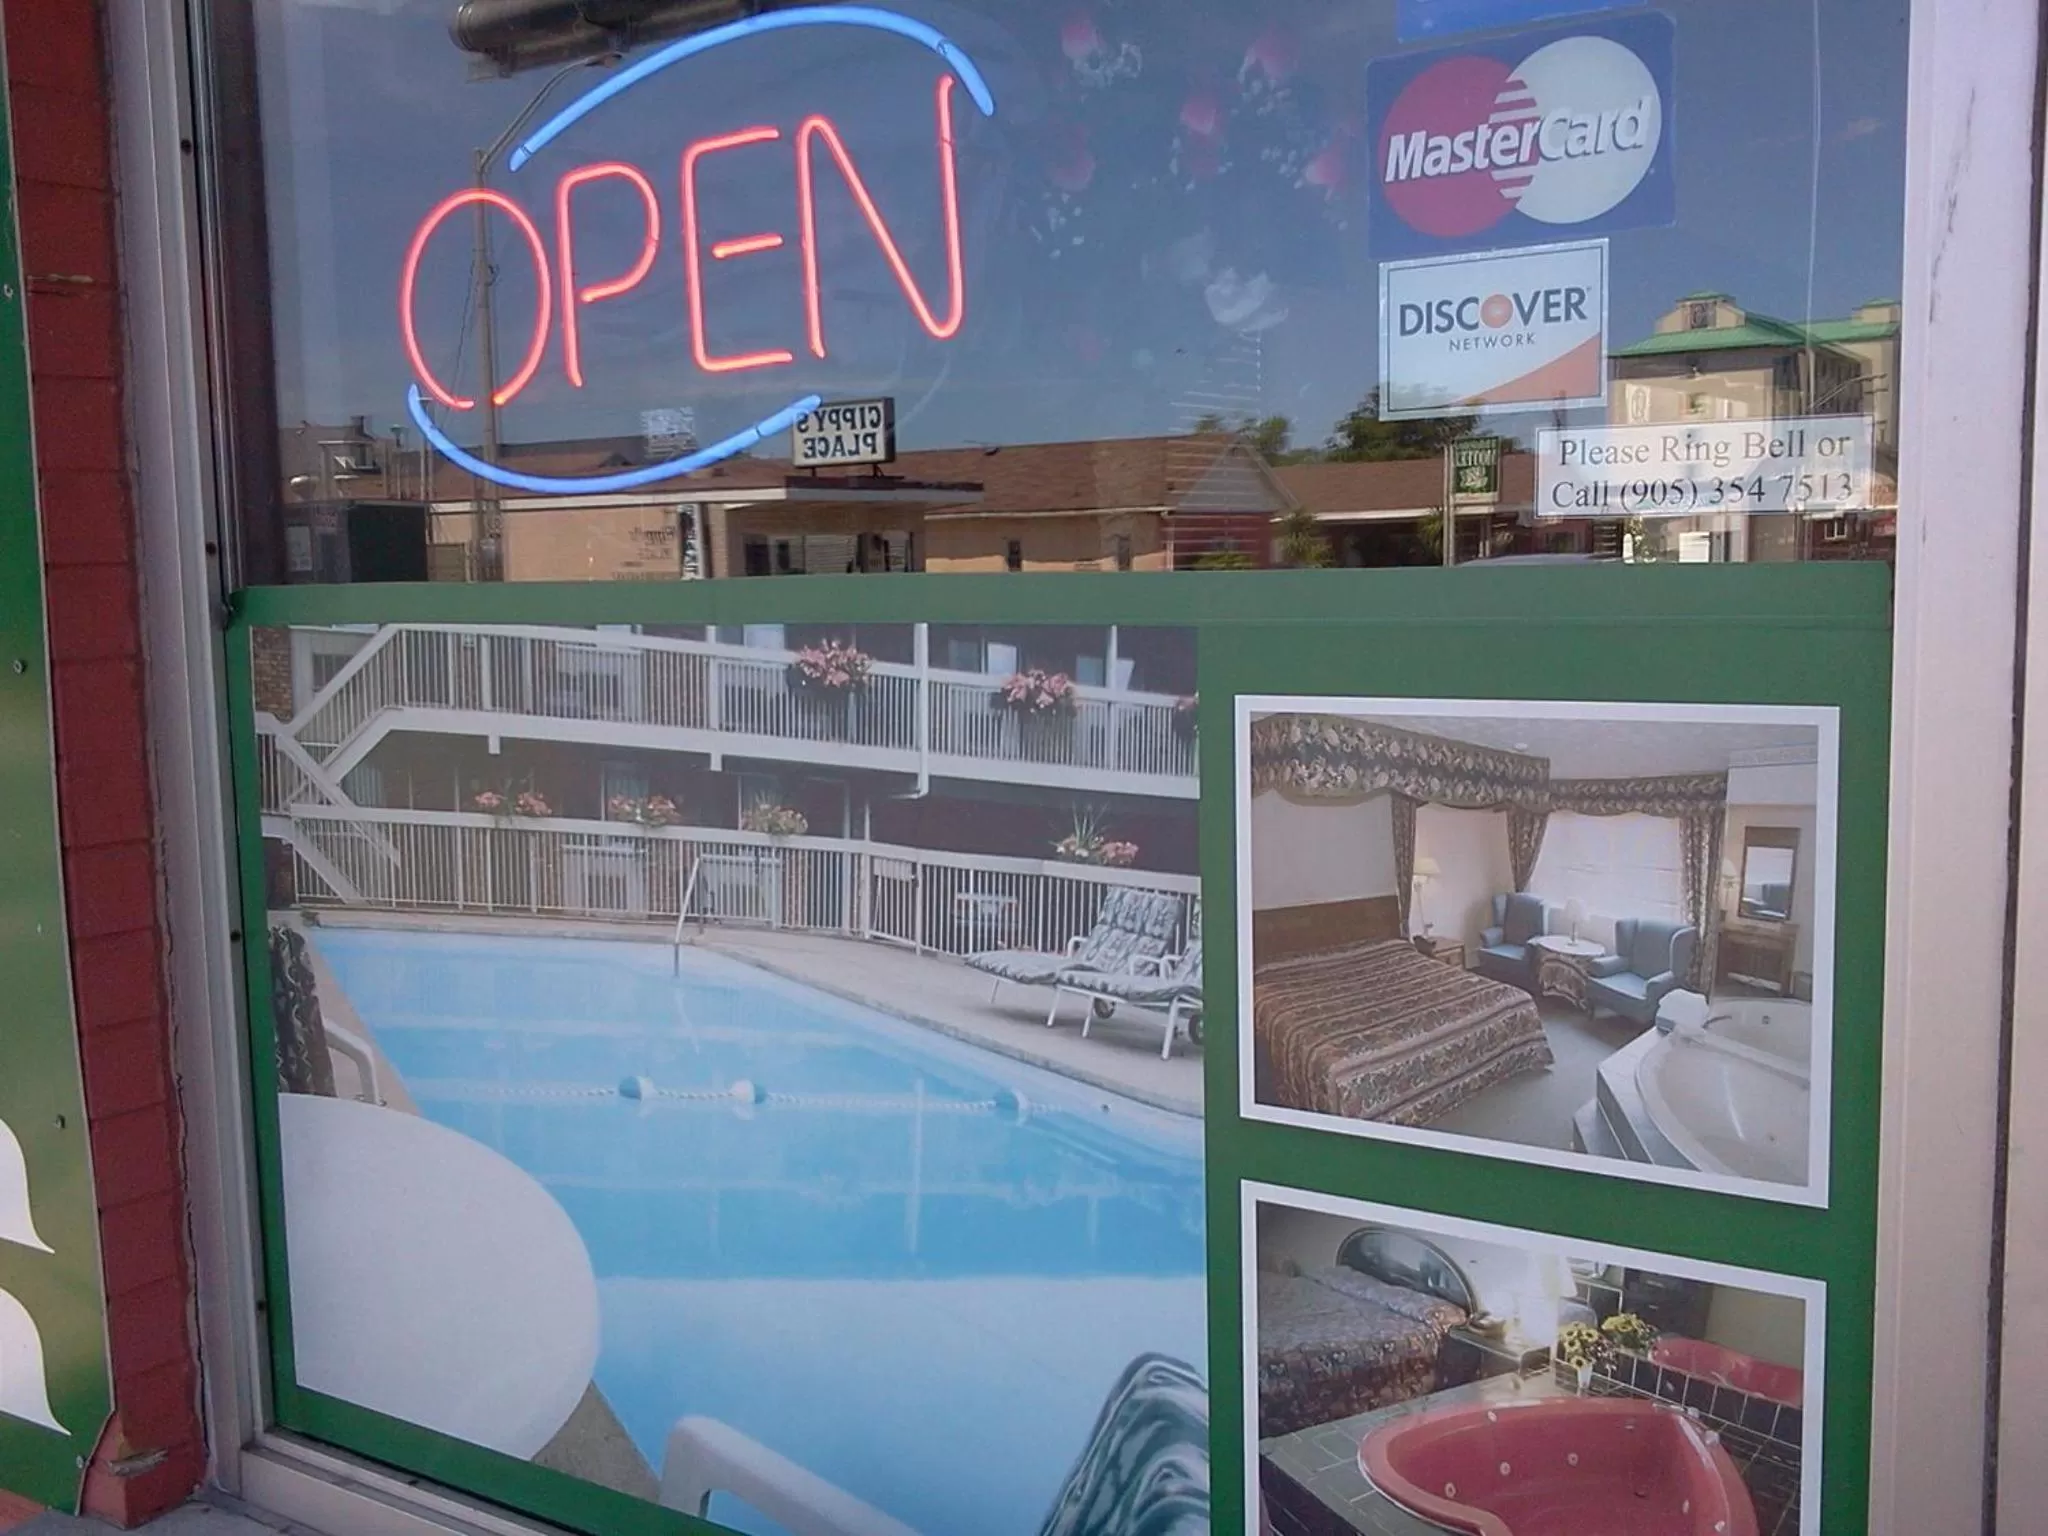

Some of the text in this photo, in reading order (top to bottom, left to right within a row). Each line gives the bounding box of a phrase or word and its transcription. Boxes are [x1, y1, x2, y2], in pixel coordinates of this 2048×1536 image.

[1383, 92, 1657, 183] MasterCard
[402, 73, 964, 409] OPEN
[1399, 286, 1589, 337] DISCOVER
[1449, 331, 1537, 353] NETWORK
[1559, 429, 1851, 468] Please Ring Bell or
[1551, 472, 1853, 513] Call (905) 354 7513
